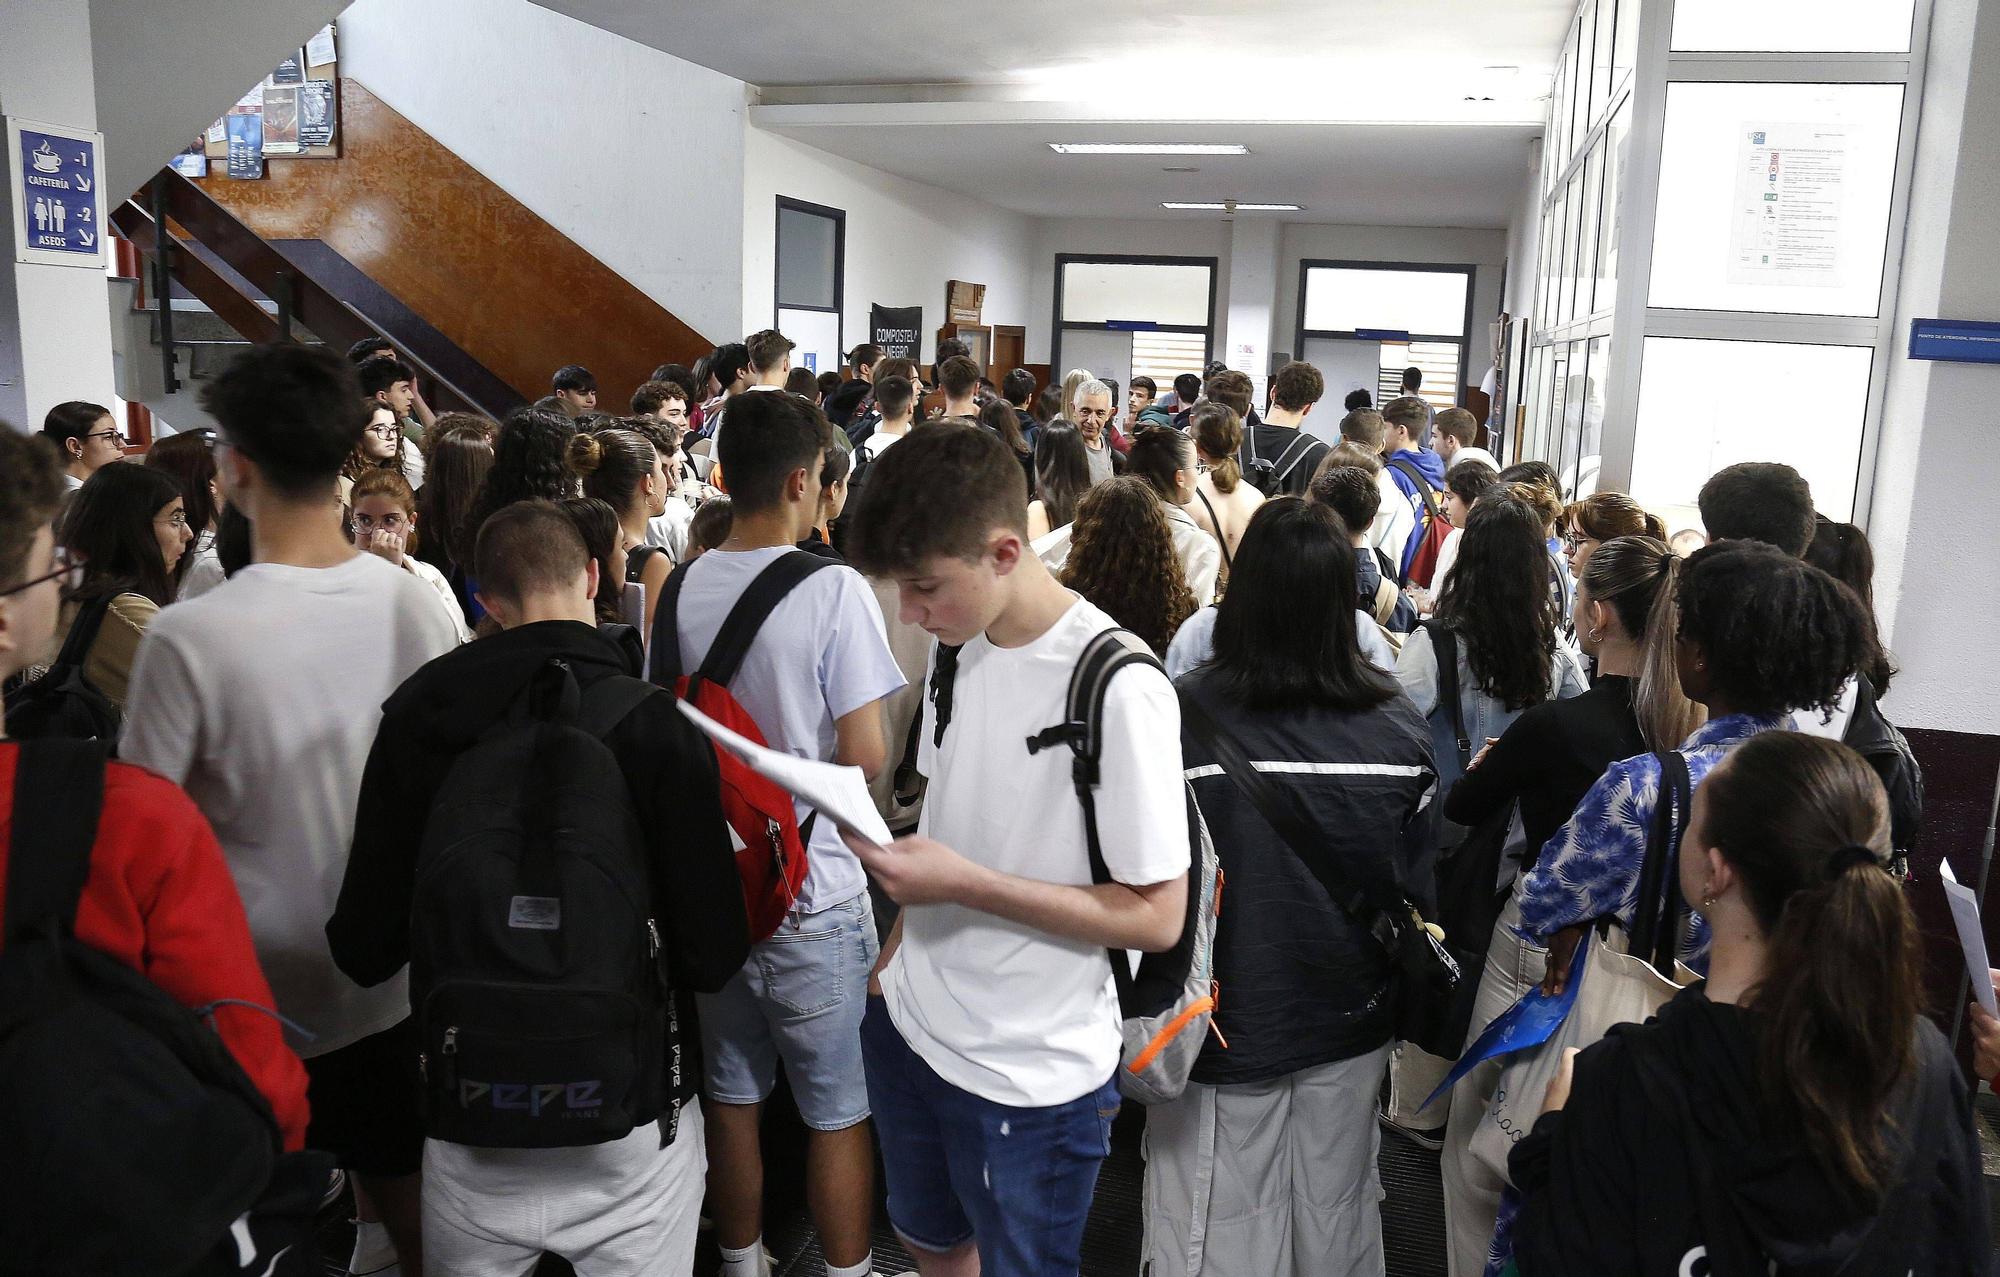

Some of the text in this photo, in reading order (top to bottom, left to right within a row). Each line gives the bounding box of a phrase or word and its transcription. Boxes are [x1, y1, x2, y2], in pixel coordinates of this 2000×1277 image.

[74, 152, 87, 166] -1
[27, 175, 70, 190] CAFETERÍA
[77, 207, 91, 222] -2
[38, 235, 66, 247] ASEOS
[887, 345, 909, 359] NEGRO
